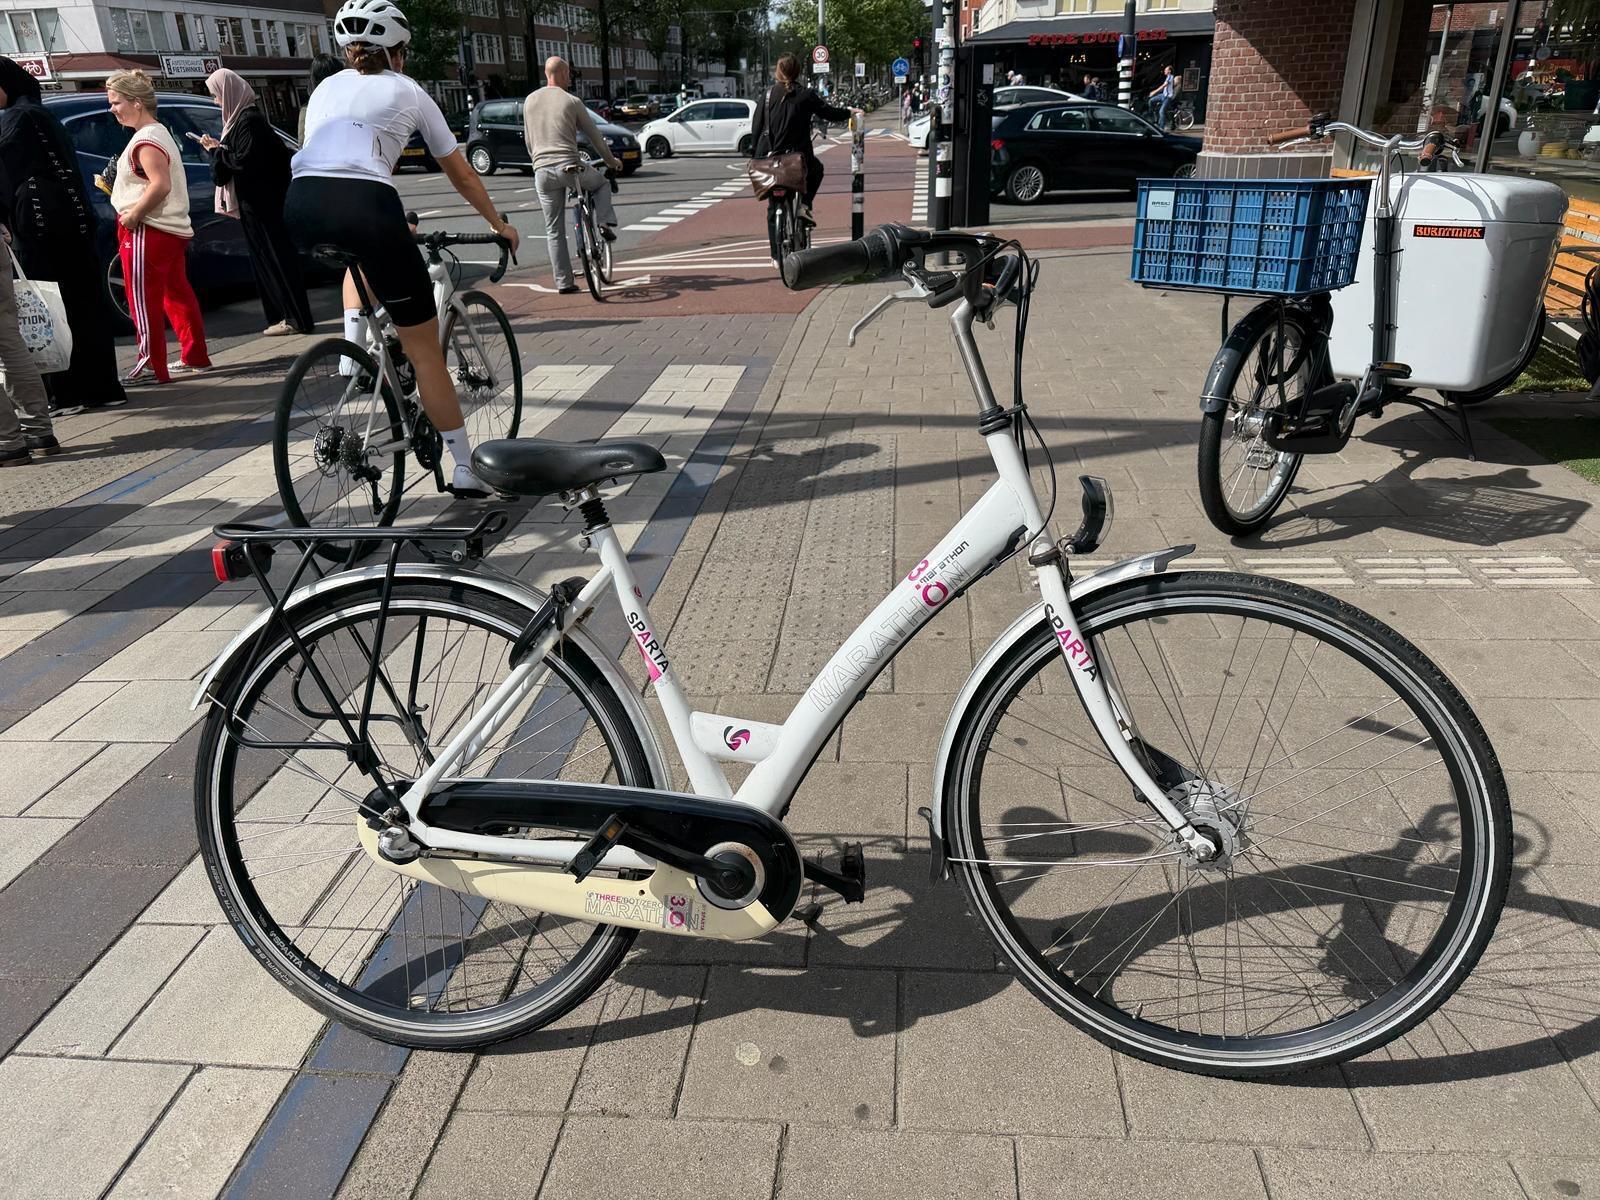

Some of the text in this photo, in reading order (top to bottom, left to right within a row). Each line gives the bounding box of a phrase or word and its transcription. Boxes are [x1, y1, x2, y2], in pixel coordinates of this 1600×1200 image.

[816, 51, 825, 59] 30
[626, 611, 670, 674] SPARTA
[1044, 603, 1098, 682] SPARTA
[273, 934, 305, 968] SPARTA
